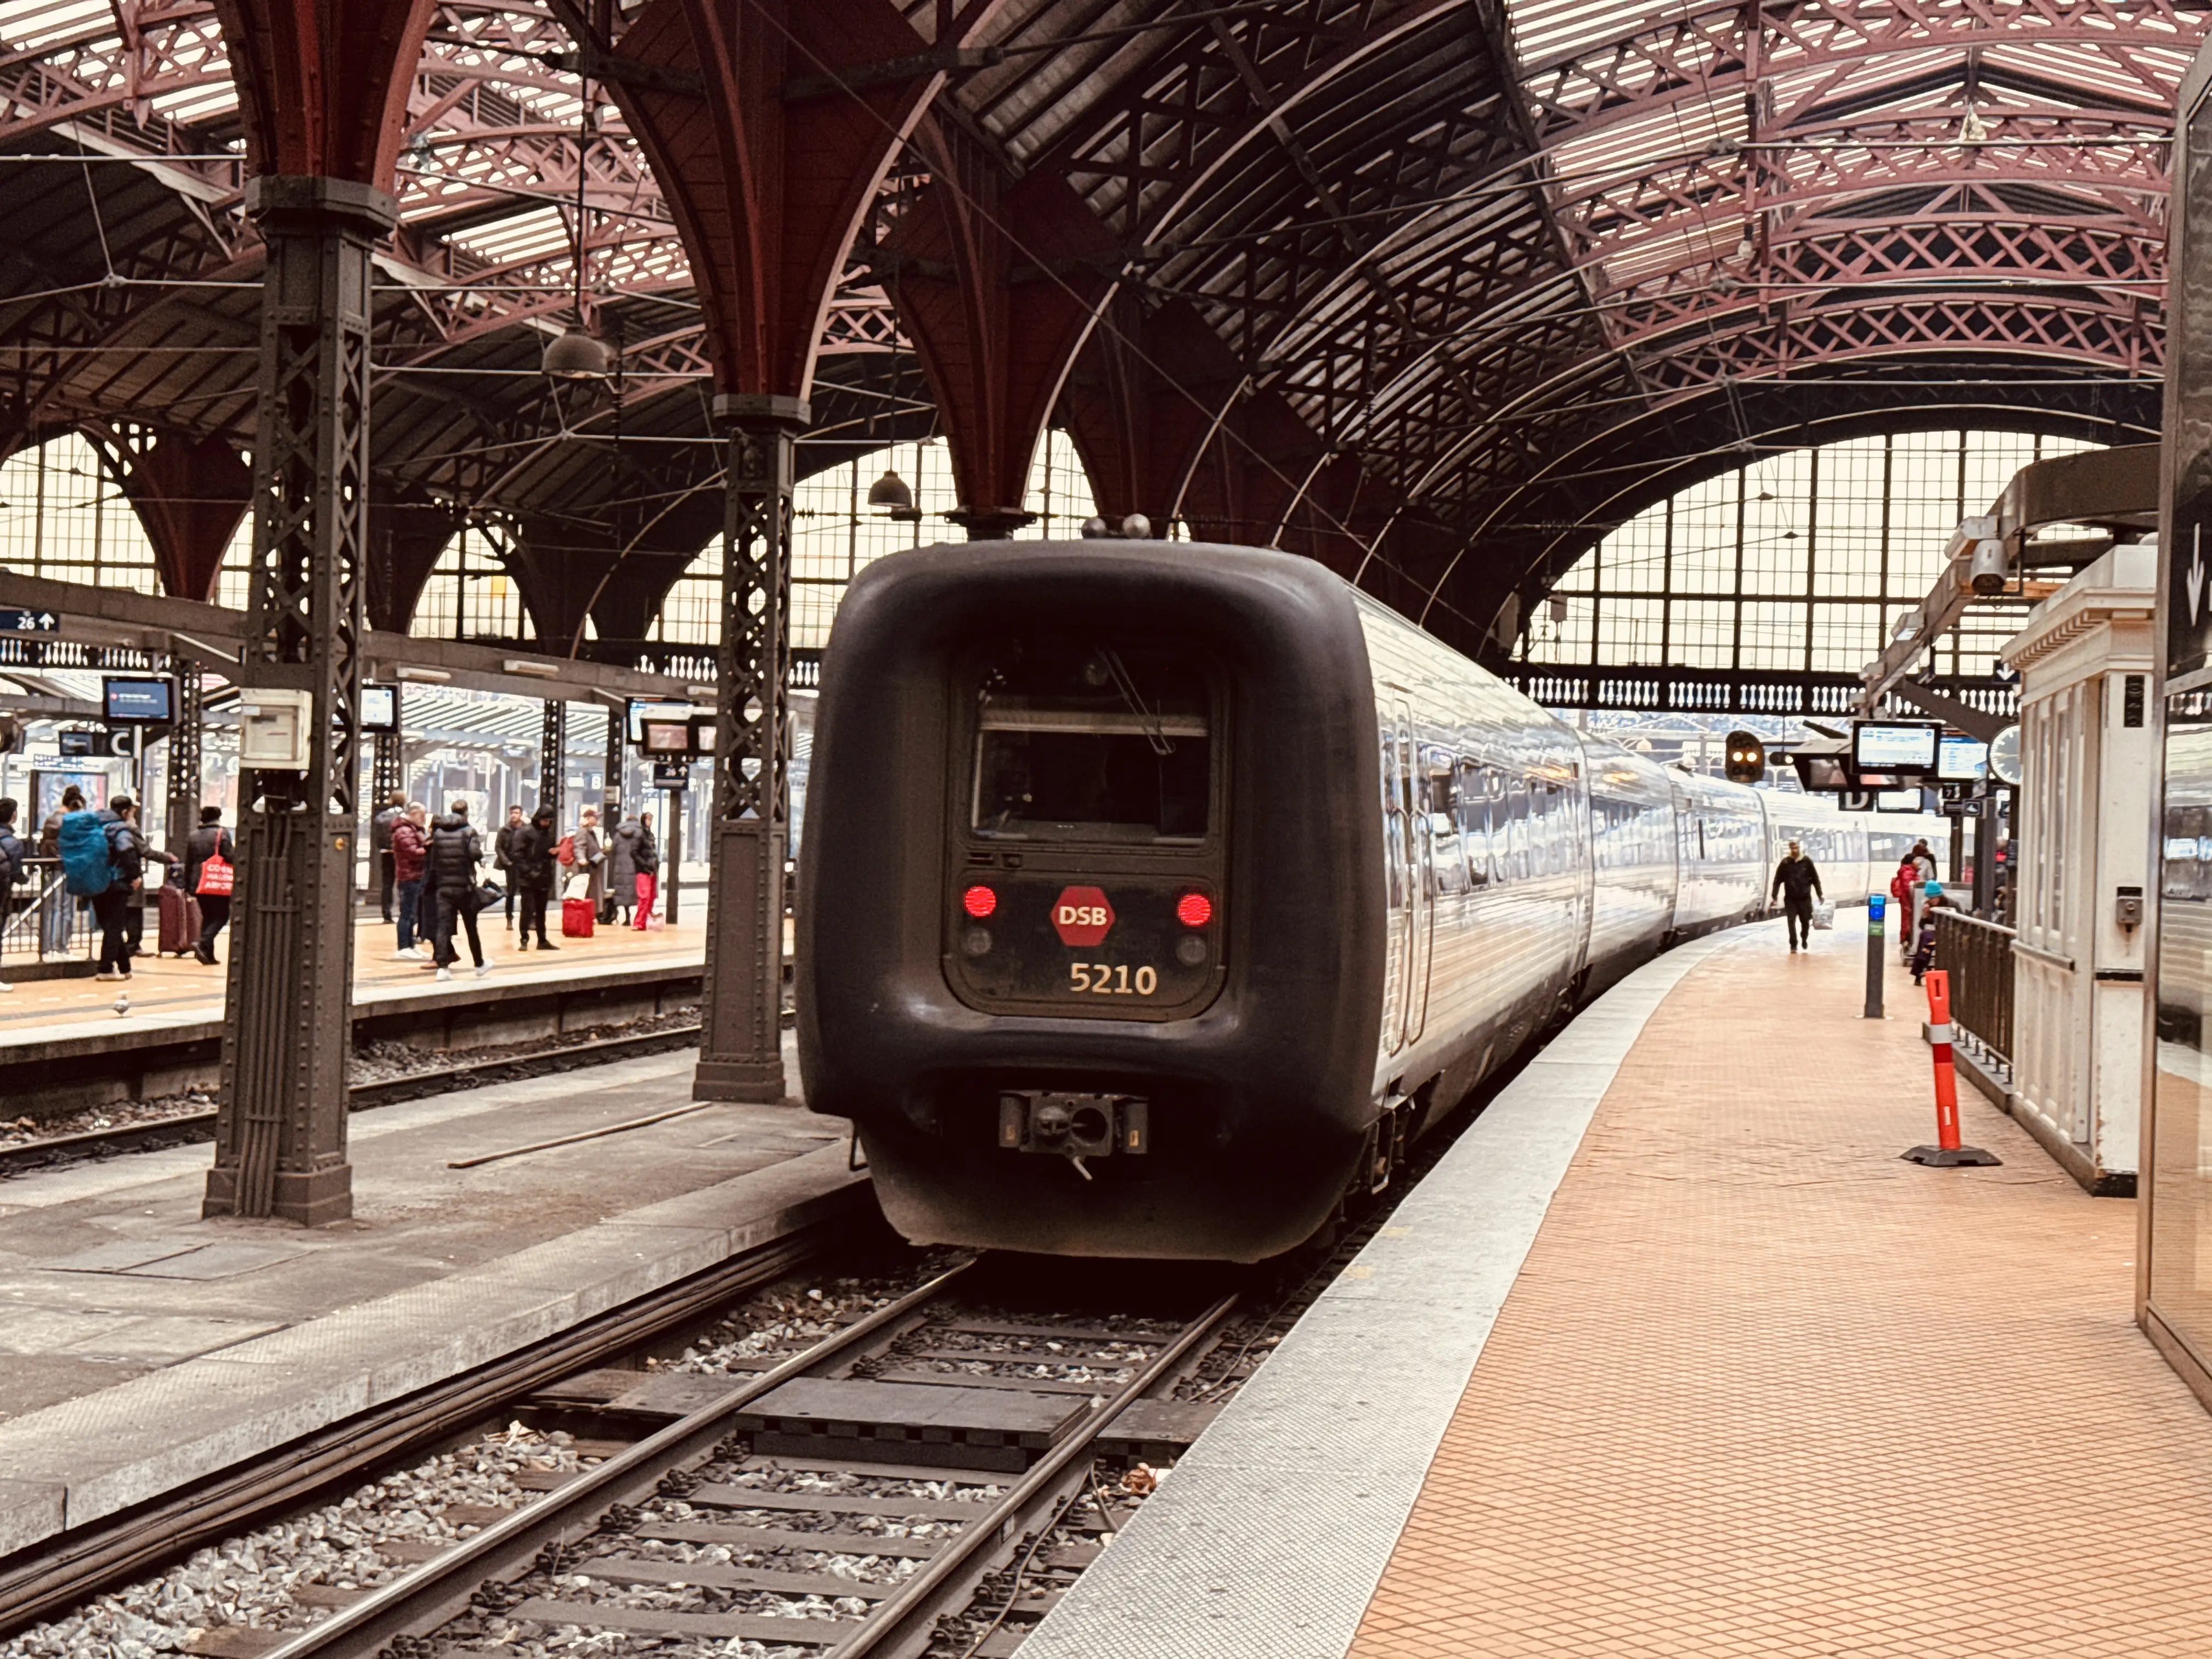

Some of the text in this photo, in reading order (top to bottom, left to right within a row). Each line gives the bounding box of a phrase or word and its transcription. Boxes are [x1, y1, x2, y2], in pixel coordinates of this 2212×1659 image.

[17, 616, 35, 630] 26
[111, 731, 131, 756] C
[1059, 906, 1107, 926] DSB
[1070, 962, 1157, 995] 5210
